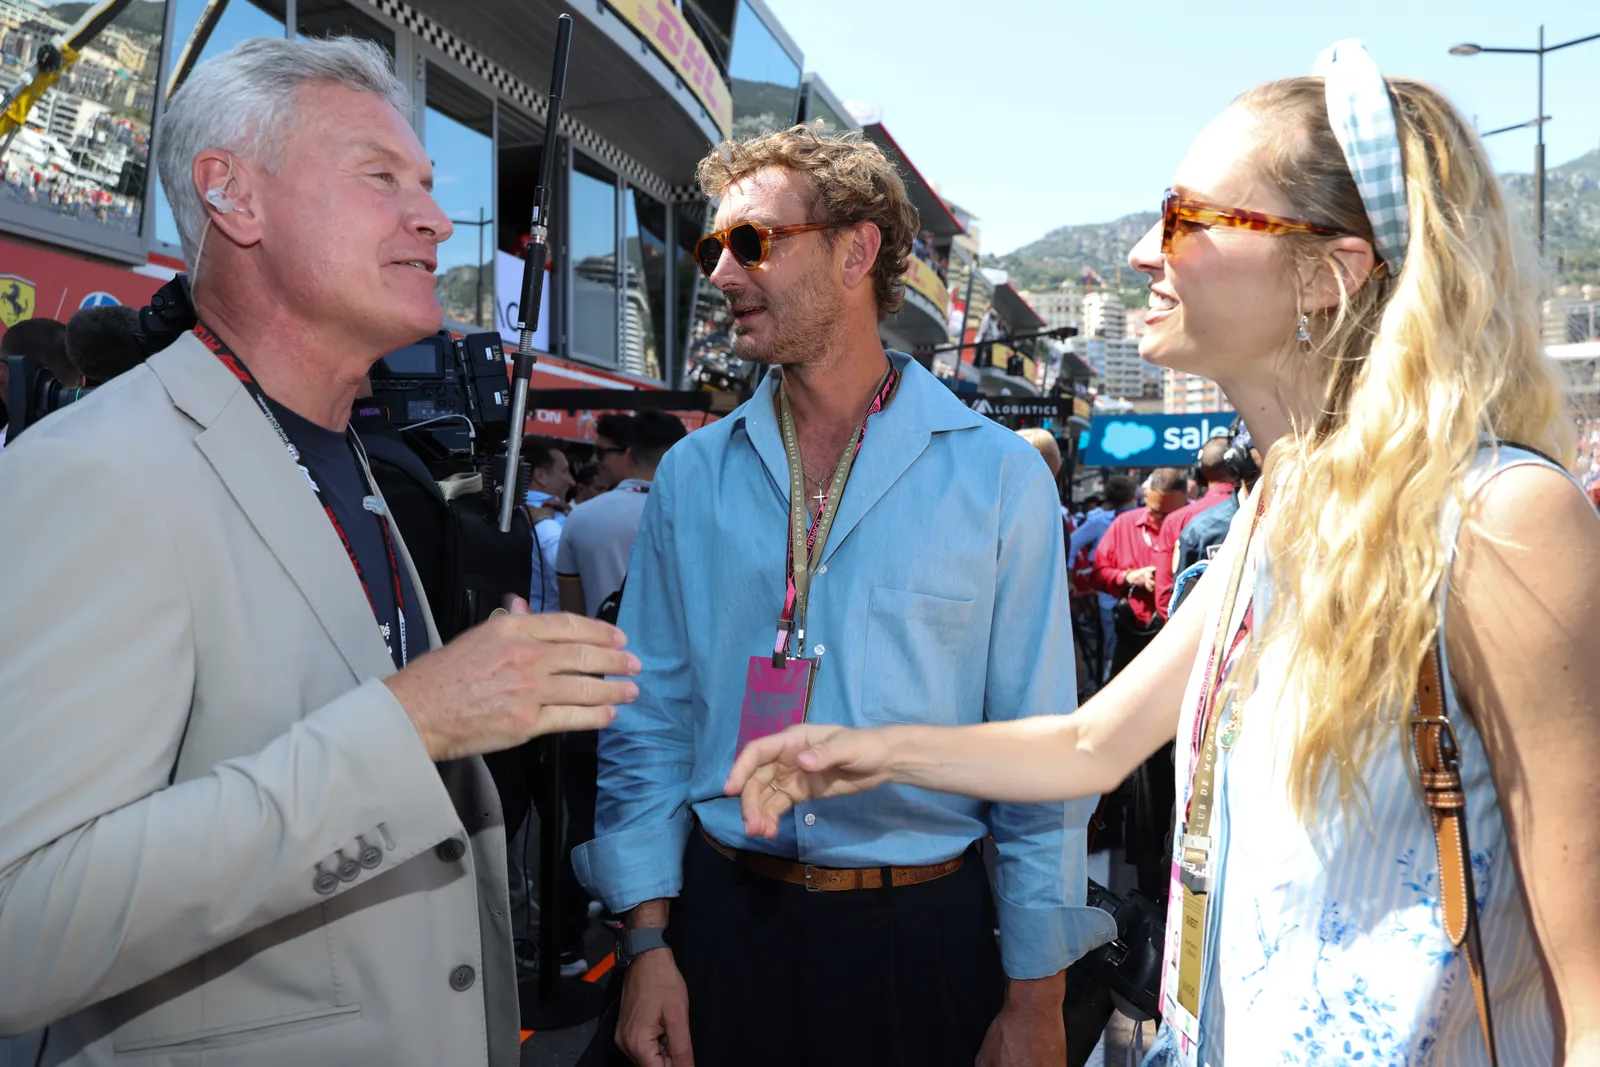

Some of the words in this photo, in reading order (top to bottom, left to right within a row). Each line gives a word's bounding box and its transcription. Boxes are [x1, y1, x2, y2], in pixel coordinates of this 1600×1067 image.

[656, 0, 717, 108] DHL
[494, 351, 502, 362] INT
[535, 409, 562, 424] ON
[995, 405, 1058, 415] LOGISTICS
[783, 412, 797, 460] AUTOMOBILE
[836, 463, 847, 483] CLUB
[795, 490, 801, 502] DE
[831, 489, 838, 500] DE
[795, 506, 803, 546] MONACO
[817, 505, 832, 543] MONACO
[749, 691, 795, 719] VIP
[1200, 779, 1209, 796] DE
[1205, 716, 1217, 772] MONACO
